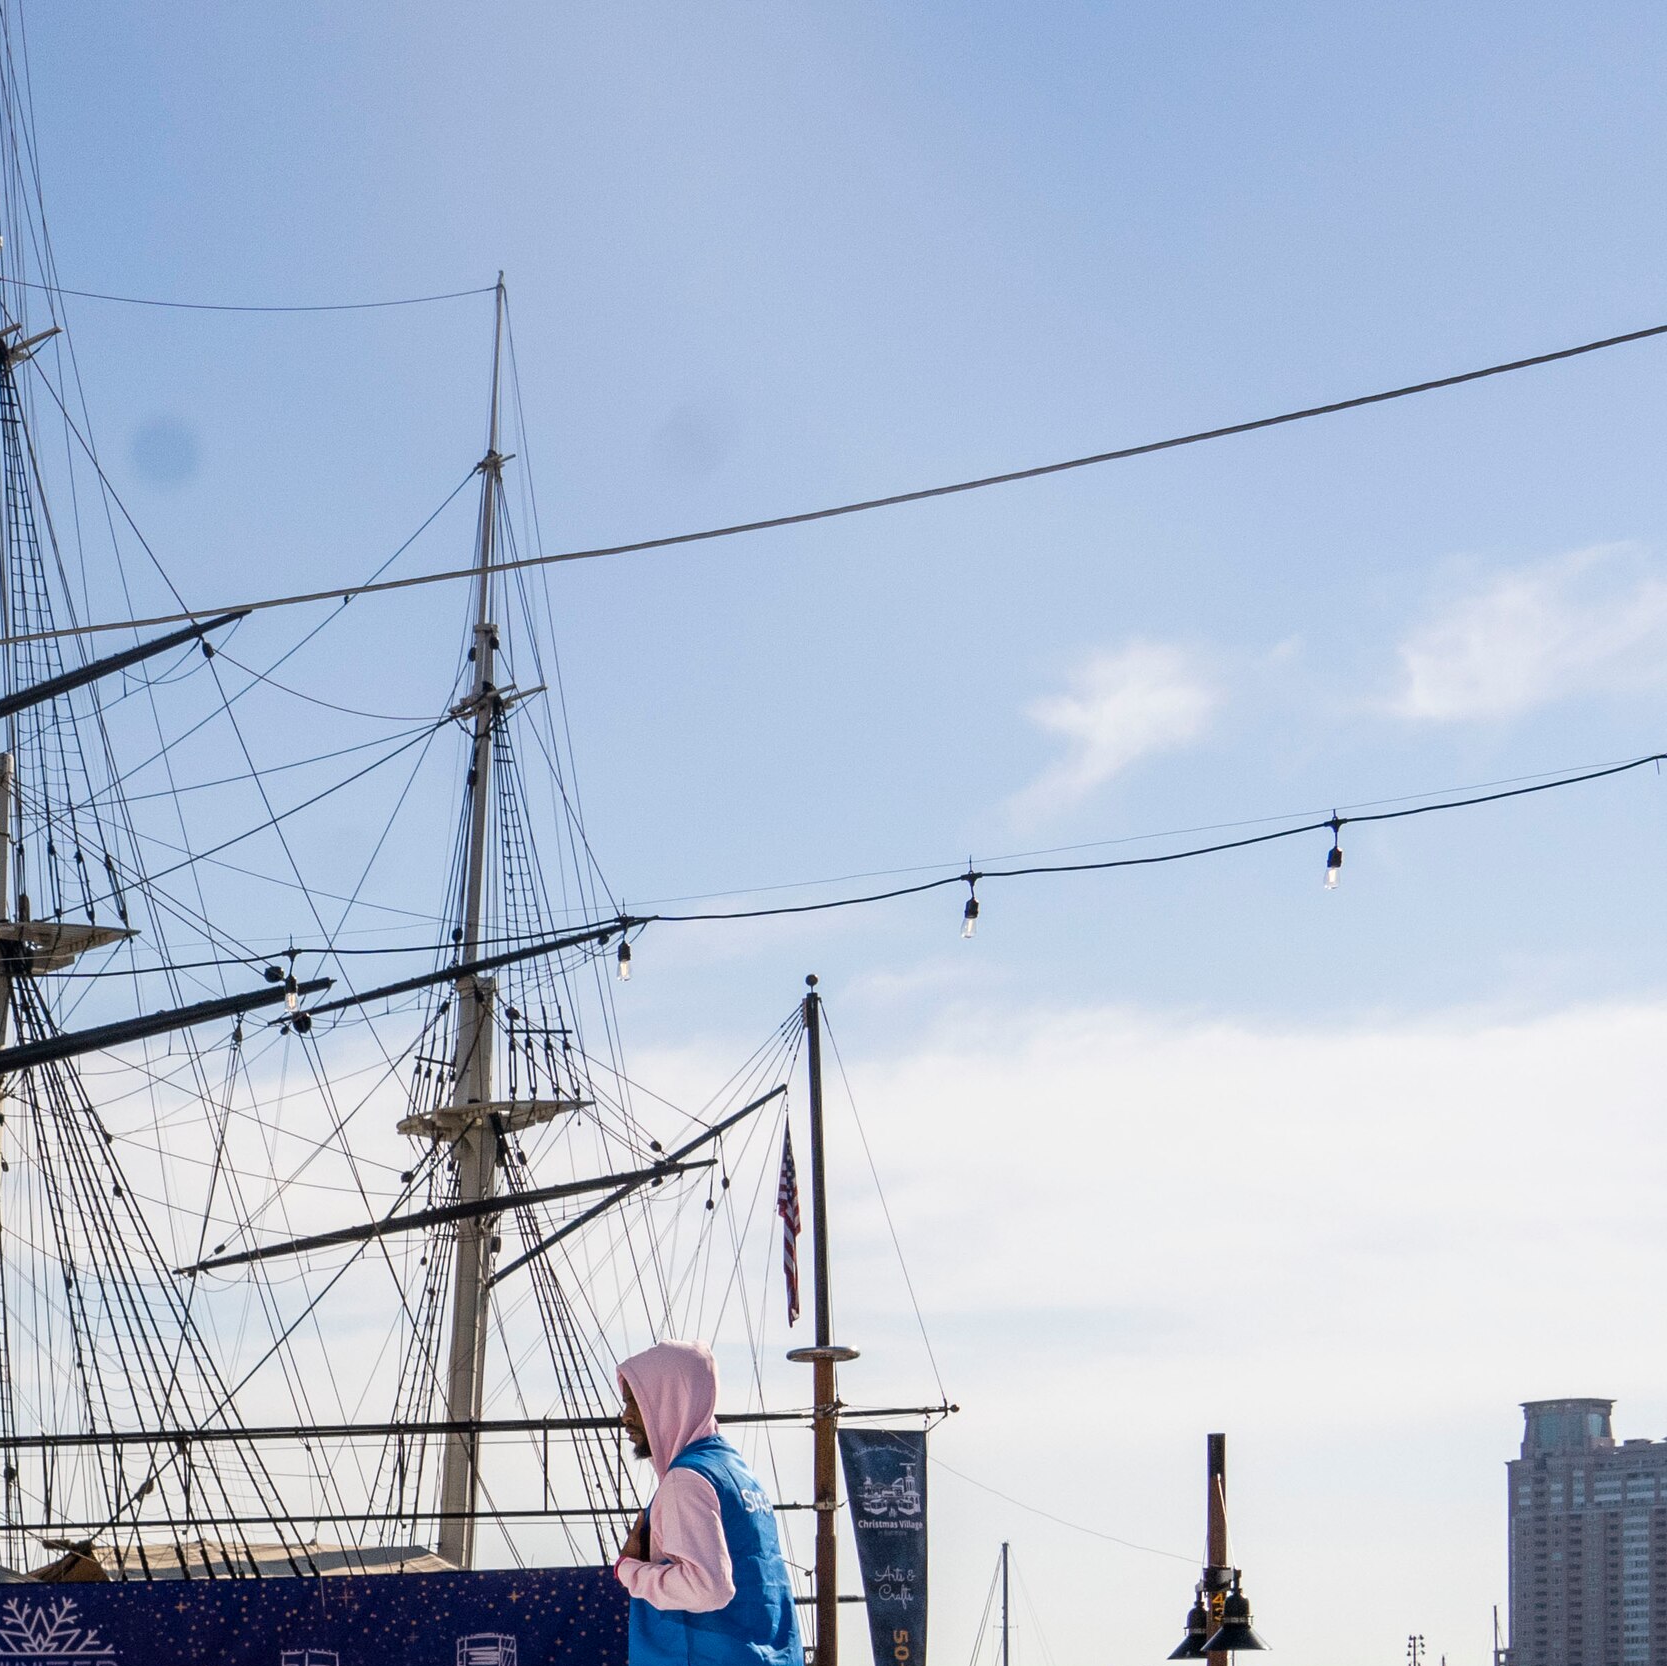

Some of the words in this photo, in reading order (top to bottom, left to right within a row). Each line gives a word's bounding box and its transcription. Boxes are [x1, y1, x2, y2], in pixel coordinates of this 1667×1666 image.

[857, 1519, 898, 1530] Christmas
[898, 1519, 924, 1532] Village
[874, 1565, 906, 1582] Arts
[907, 1569, 916, 1582] &
[878, 1583, 914, 1610] Crafts
